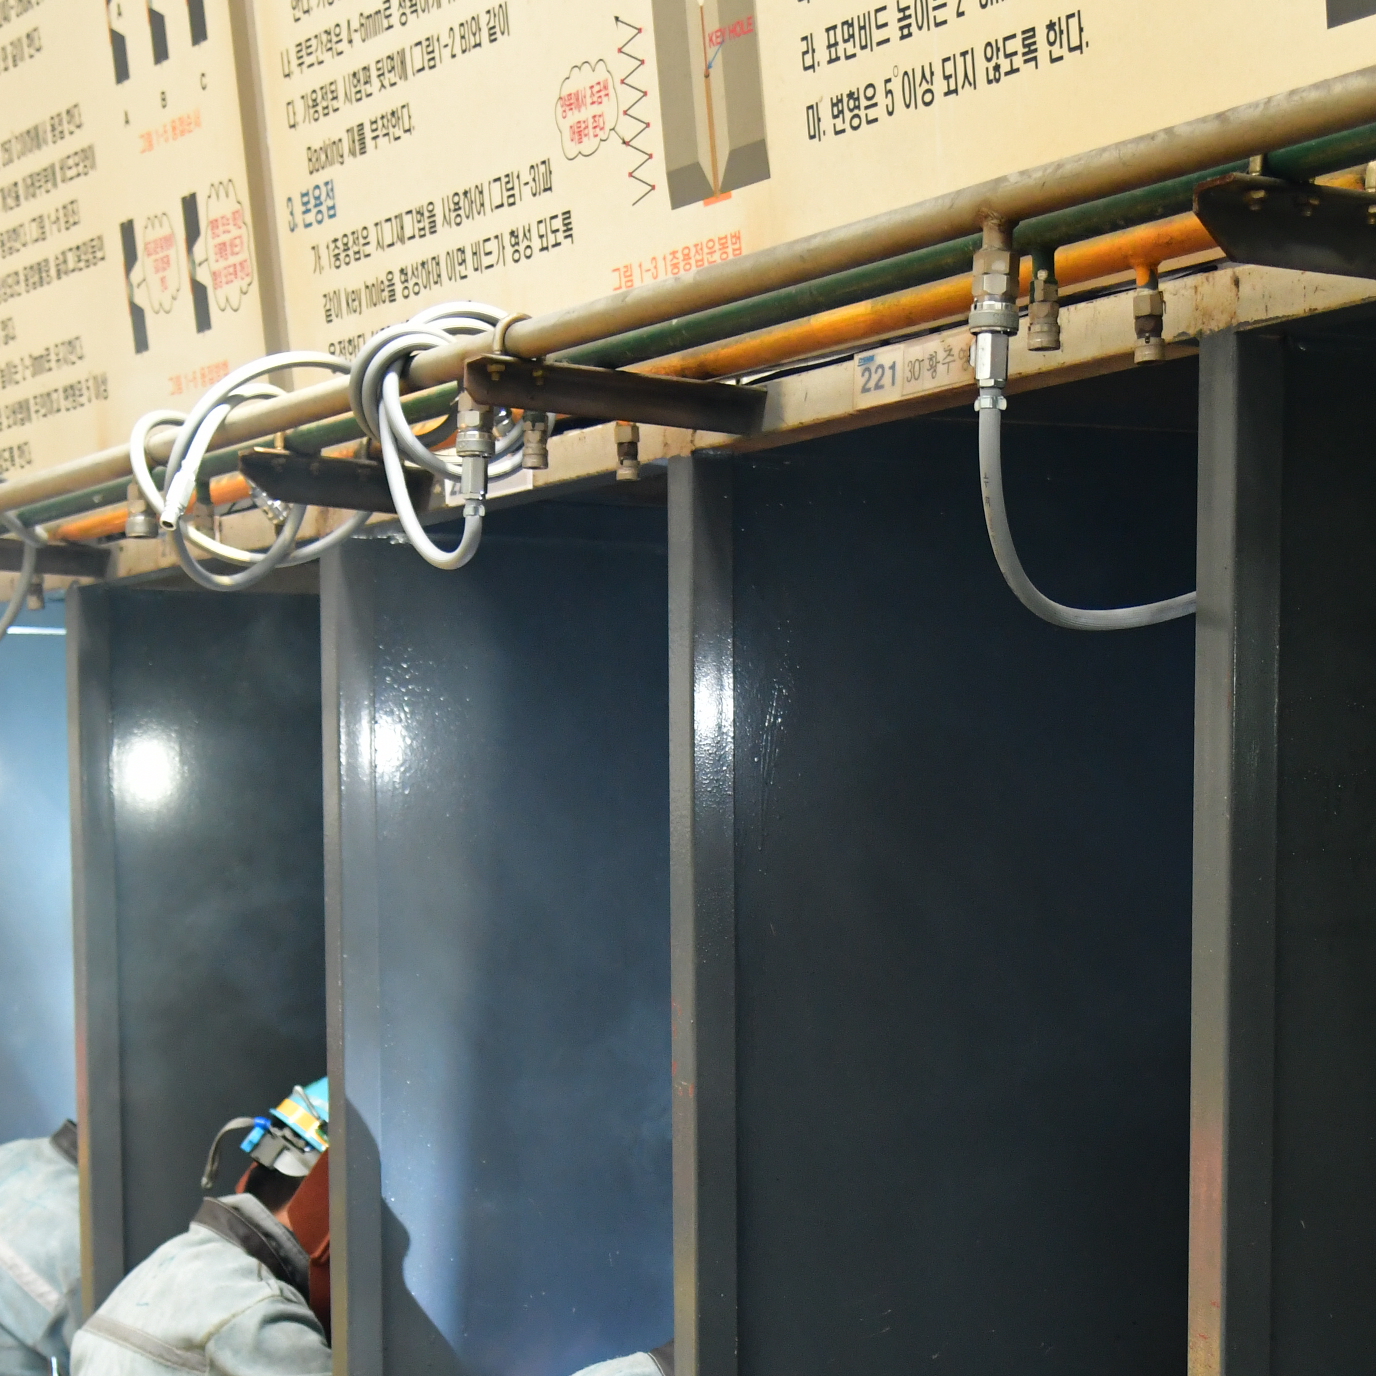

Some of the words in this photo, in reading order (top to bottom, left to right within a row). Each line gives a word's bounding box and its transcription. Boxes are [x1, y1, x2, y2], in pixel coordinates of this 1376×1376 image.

[280, 49, 294, 79] 나.
[294, 22, 344, 74] 루트간격은
[708, 27, 727, 48] KEY
[728, 16, 754, 41] HOLE
[800, 33, 820, 73] 라.
[825, 6, 890, 65] 표면비드
[200, 72, 207, 91] C
[285, 99, 299, 130] 다.
[300, 79, 340, 124] 가용접된
[343, 64, 373, 105] 시험편
[375, 47, 408, 92] 뒷면에
[485, 1, 510, 44] 같이
[806, 102, 825, 142] 마.
[830, 82, 879, 136] 변형은
[941, 47, 976, 97] 되지
[984, 26, 1038, 85] 않도록
[1046, 10, 1089, 64] 한다.
[124, 110, 130, 125] A
[161, 91, 167, 109] B
[591, 112, 605, 138] 준다
[306, 137, 345, 176] Backing
[345, 122, 367, 158] 재를
[369, 102, 415, 150] 부착한다.
[286, 196, 298, 233] 3.
[300, 179, 337, 229] 본용접
[310, 244, 324, 275] 가.
[326, 226, 371, 270] 1층용접은
[373, 201, 437, 252] 지그재그법을
[441, 182, 486, 228] 사용하여
[322, 289, 343, 324] 같이
[344, 288, 362, 316] key
[364, 270, 397, 309] hole을
[398, 254, 442, 300] 형성하며
[445, 245, 468, 282] 이면
[470, 232, 506, 274] 비드가
[508, 223, 533, 264] 형성
[536, 209, 574, 252] 되도록
[611, 263, 634, 291] 그림
[638, 256, 659, 283] 1-3
[663, 229, 743, 277] 1층용접운봉법
[861, 361, 896, 394] 221
